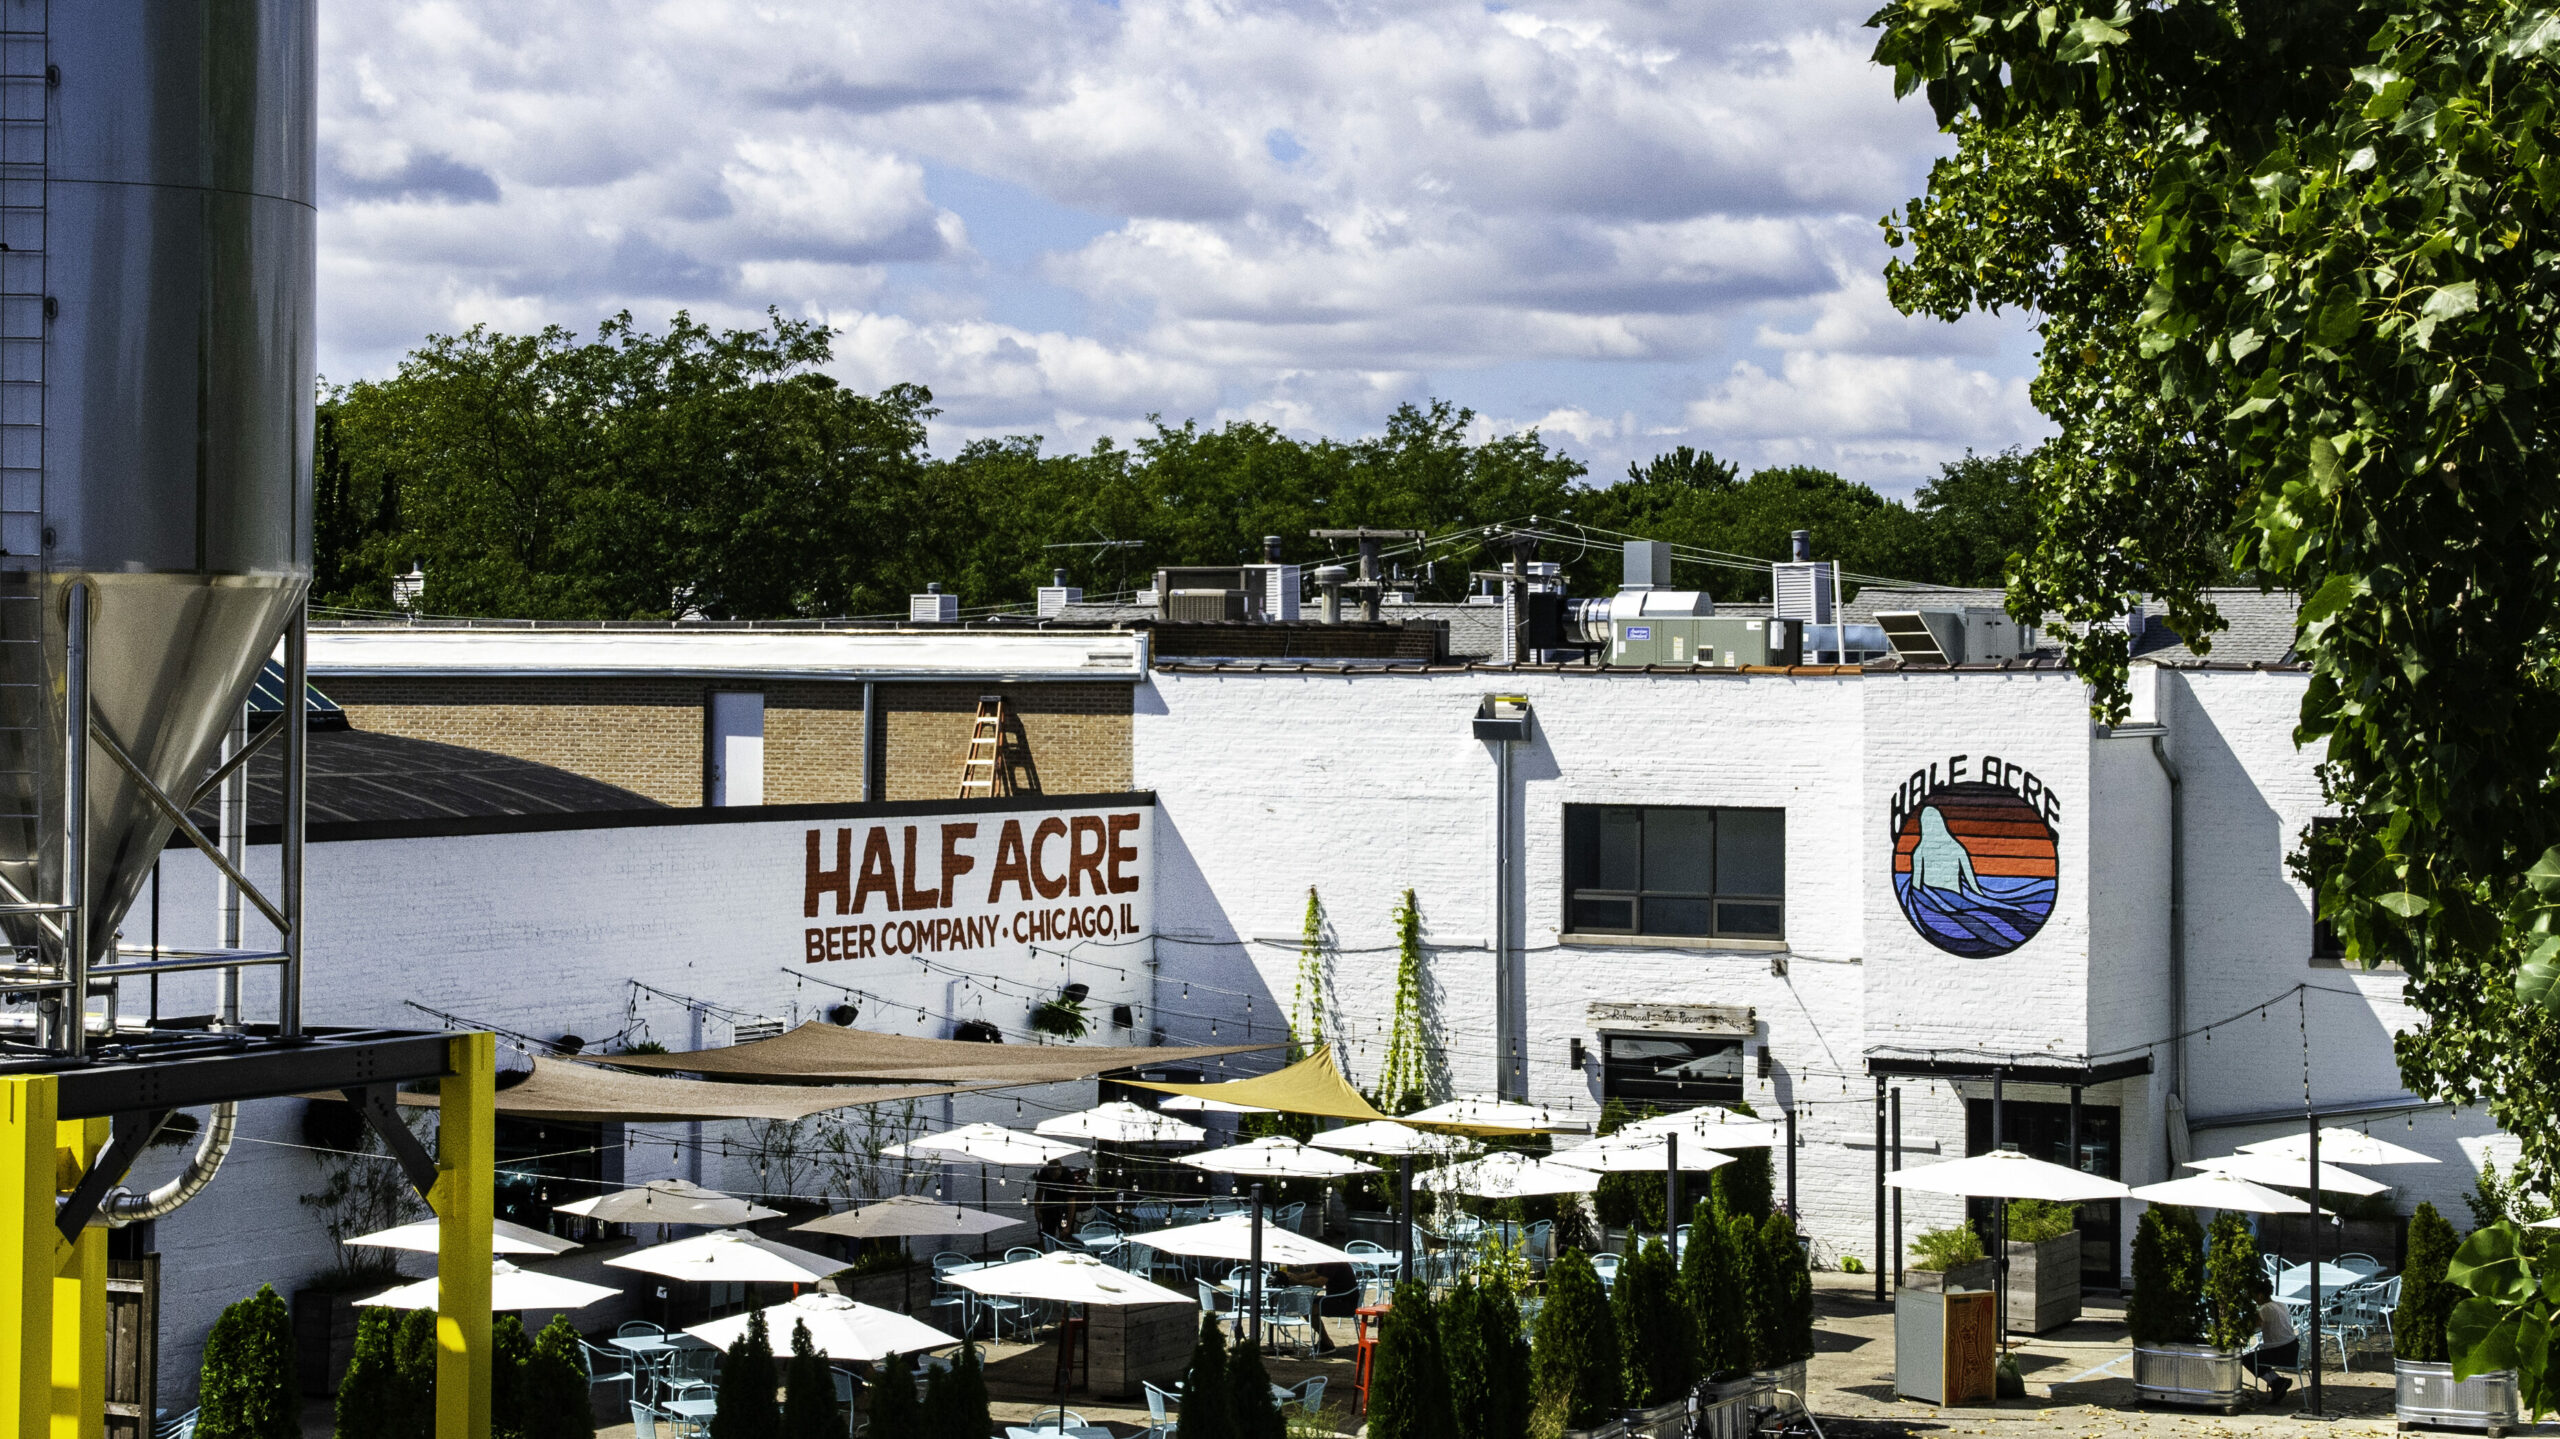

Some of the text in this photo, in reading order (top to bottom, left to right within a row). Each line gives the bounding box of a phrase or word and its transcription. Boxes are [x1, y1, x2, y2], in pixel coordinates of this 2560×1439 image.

[1983, 755, 2060, 847] ACRE
[804, 813, 1141, 917] HALF ACRE
[805, 922, 876, 963] BEER
[881, 914, 1001, 955] COMPANY
